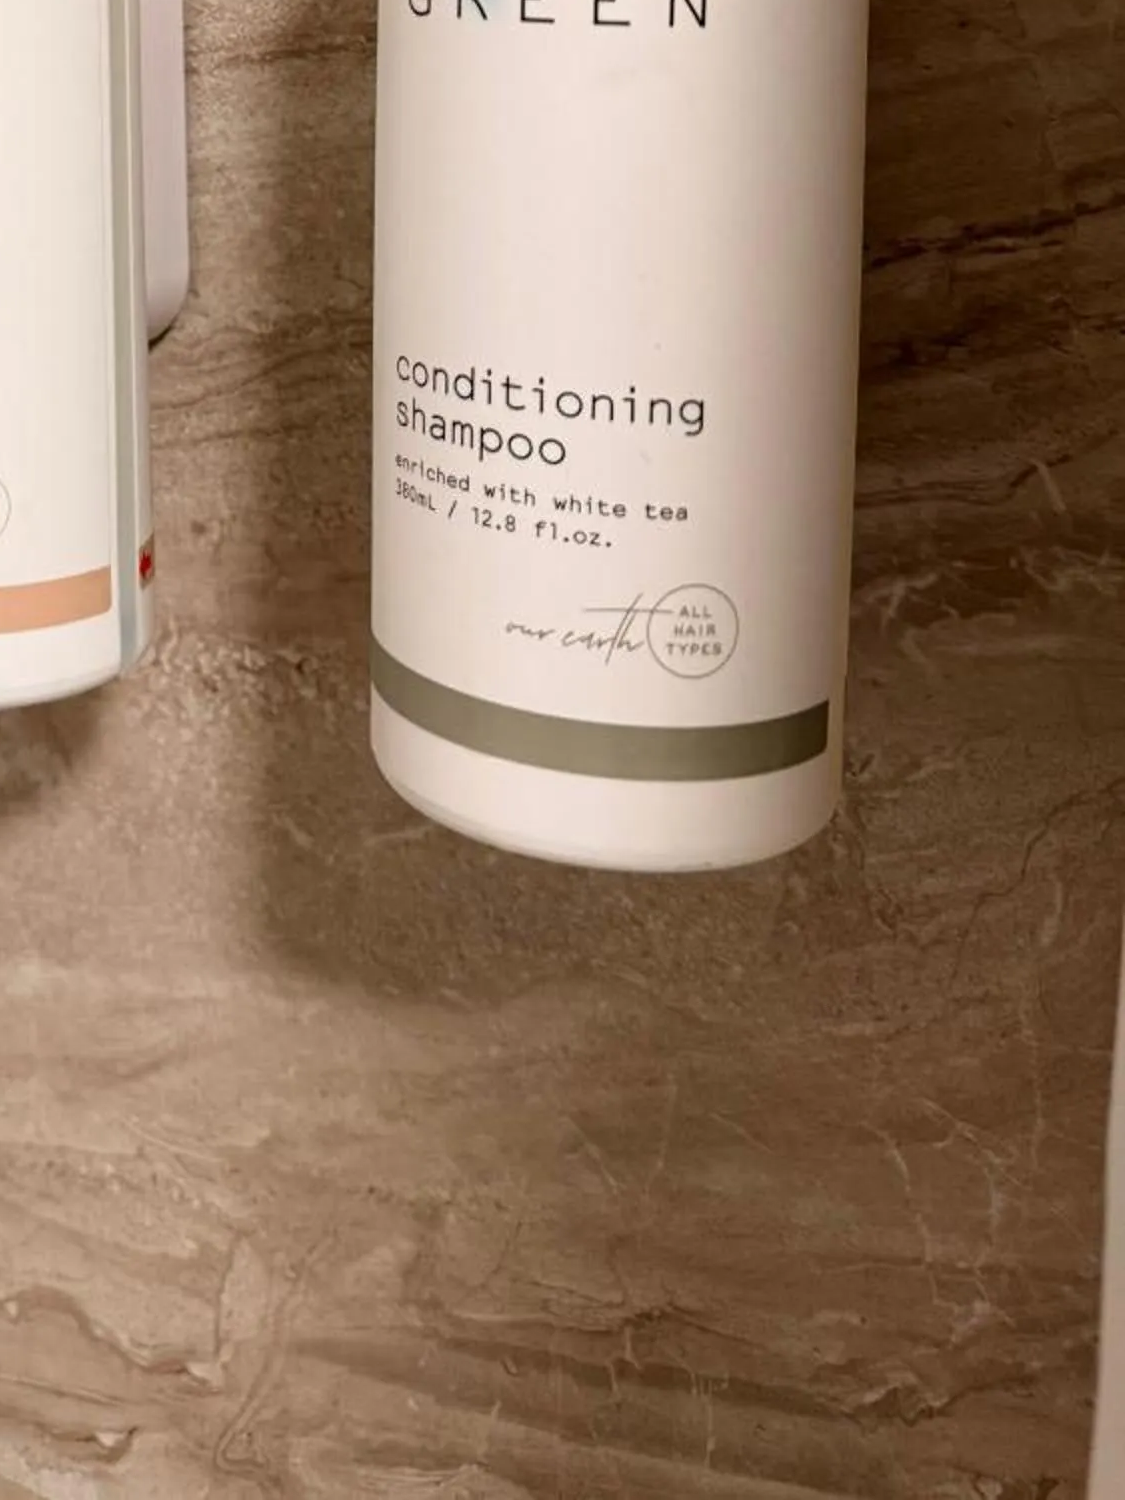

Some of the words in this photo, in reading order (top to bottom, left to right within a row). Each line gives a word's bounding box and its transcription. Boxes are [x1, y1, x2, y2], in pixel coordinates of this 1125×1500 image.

[396, 354, 705, 437] conditioning
[396, 396, 567, 466] shampoo
[395, 453, 470, 493] enriched
[483, 482, 537, 508] with
[553, 493, 626, 519] white
[644, 503, 689, 522] tea
[470, 506, 517, 533] 12.8
[535, 521, 613, 549] fl.oz.
[673, 622, 717, 637] HAIR
[679, 604, 714, 619] ALL
[665, 641, 724, 657] TYPES
